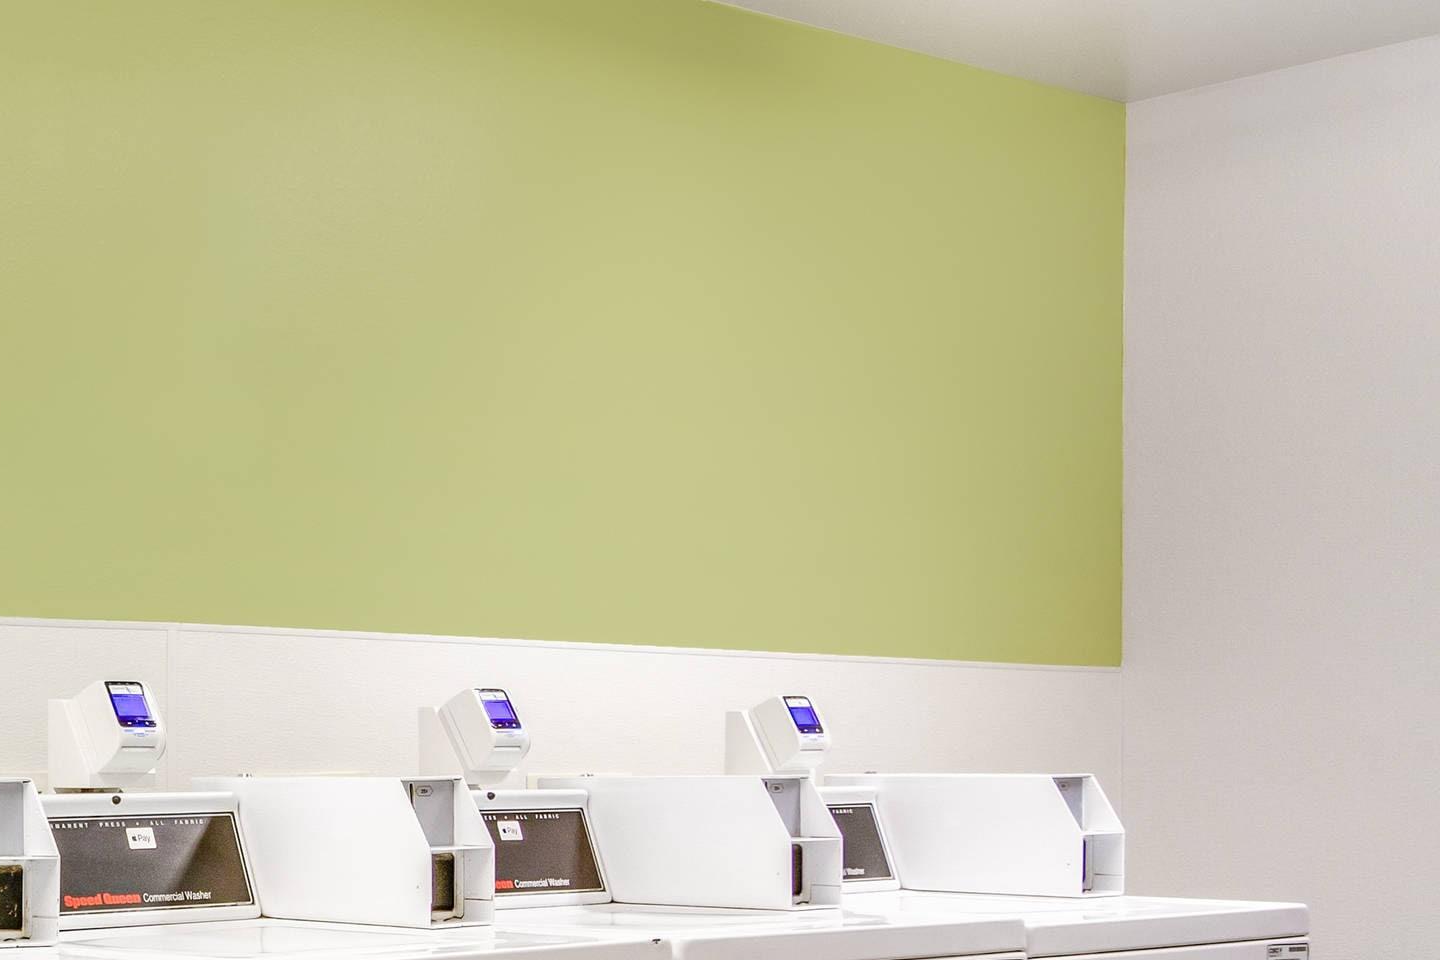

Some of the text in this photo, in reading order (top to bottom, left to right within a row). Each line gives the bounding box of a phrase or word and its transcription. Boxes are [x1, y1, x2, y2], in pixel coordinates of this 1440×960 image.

[137, 834, 151, 843] Pay
[63, 891, 212, 908] Speed Queen Commercial Washer
